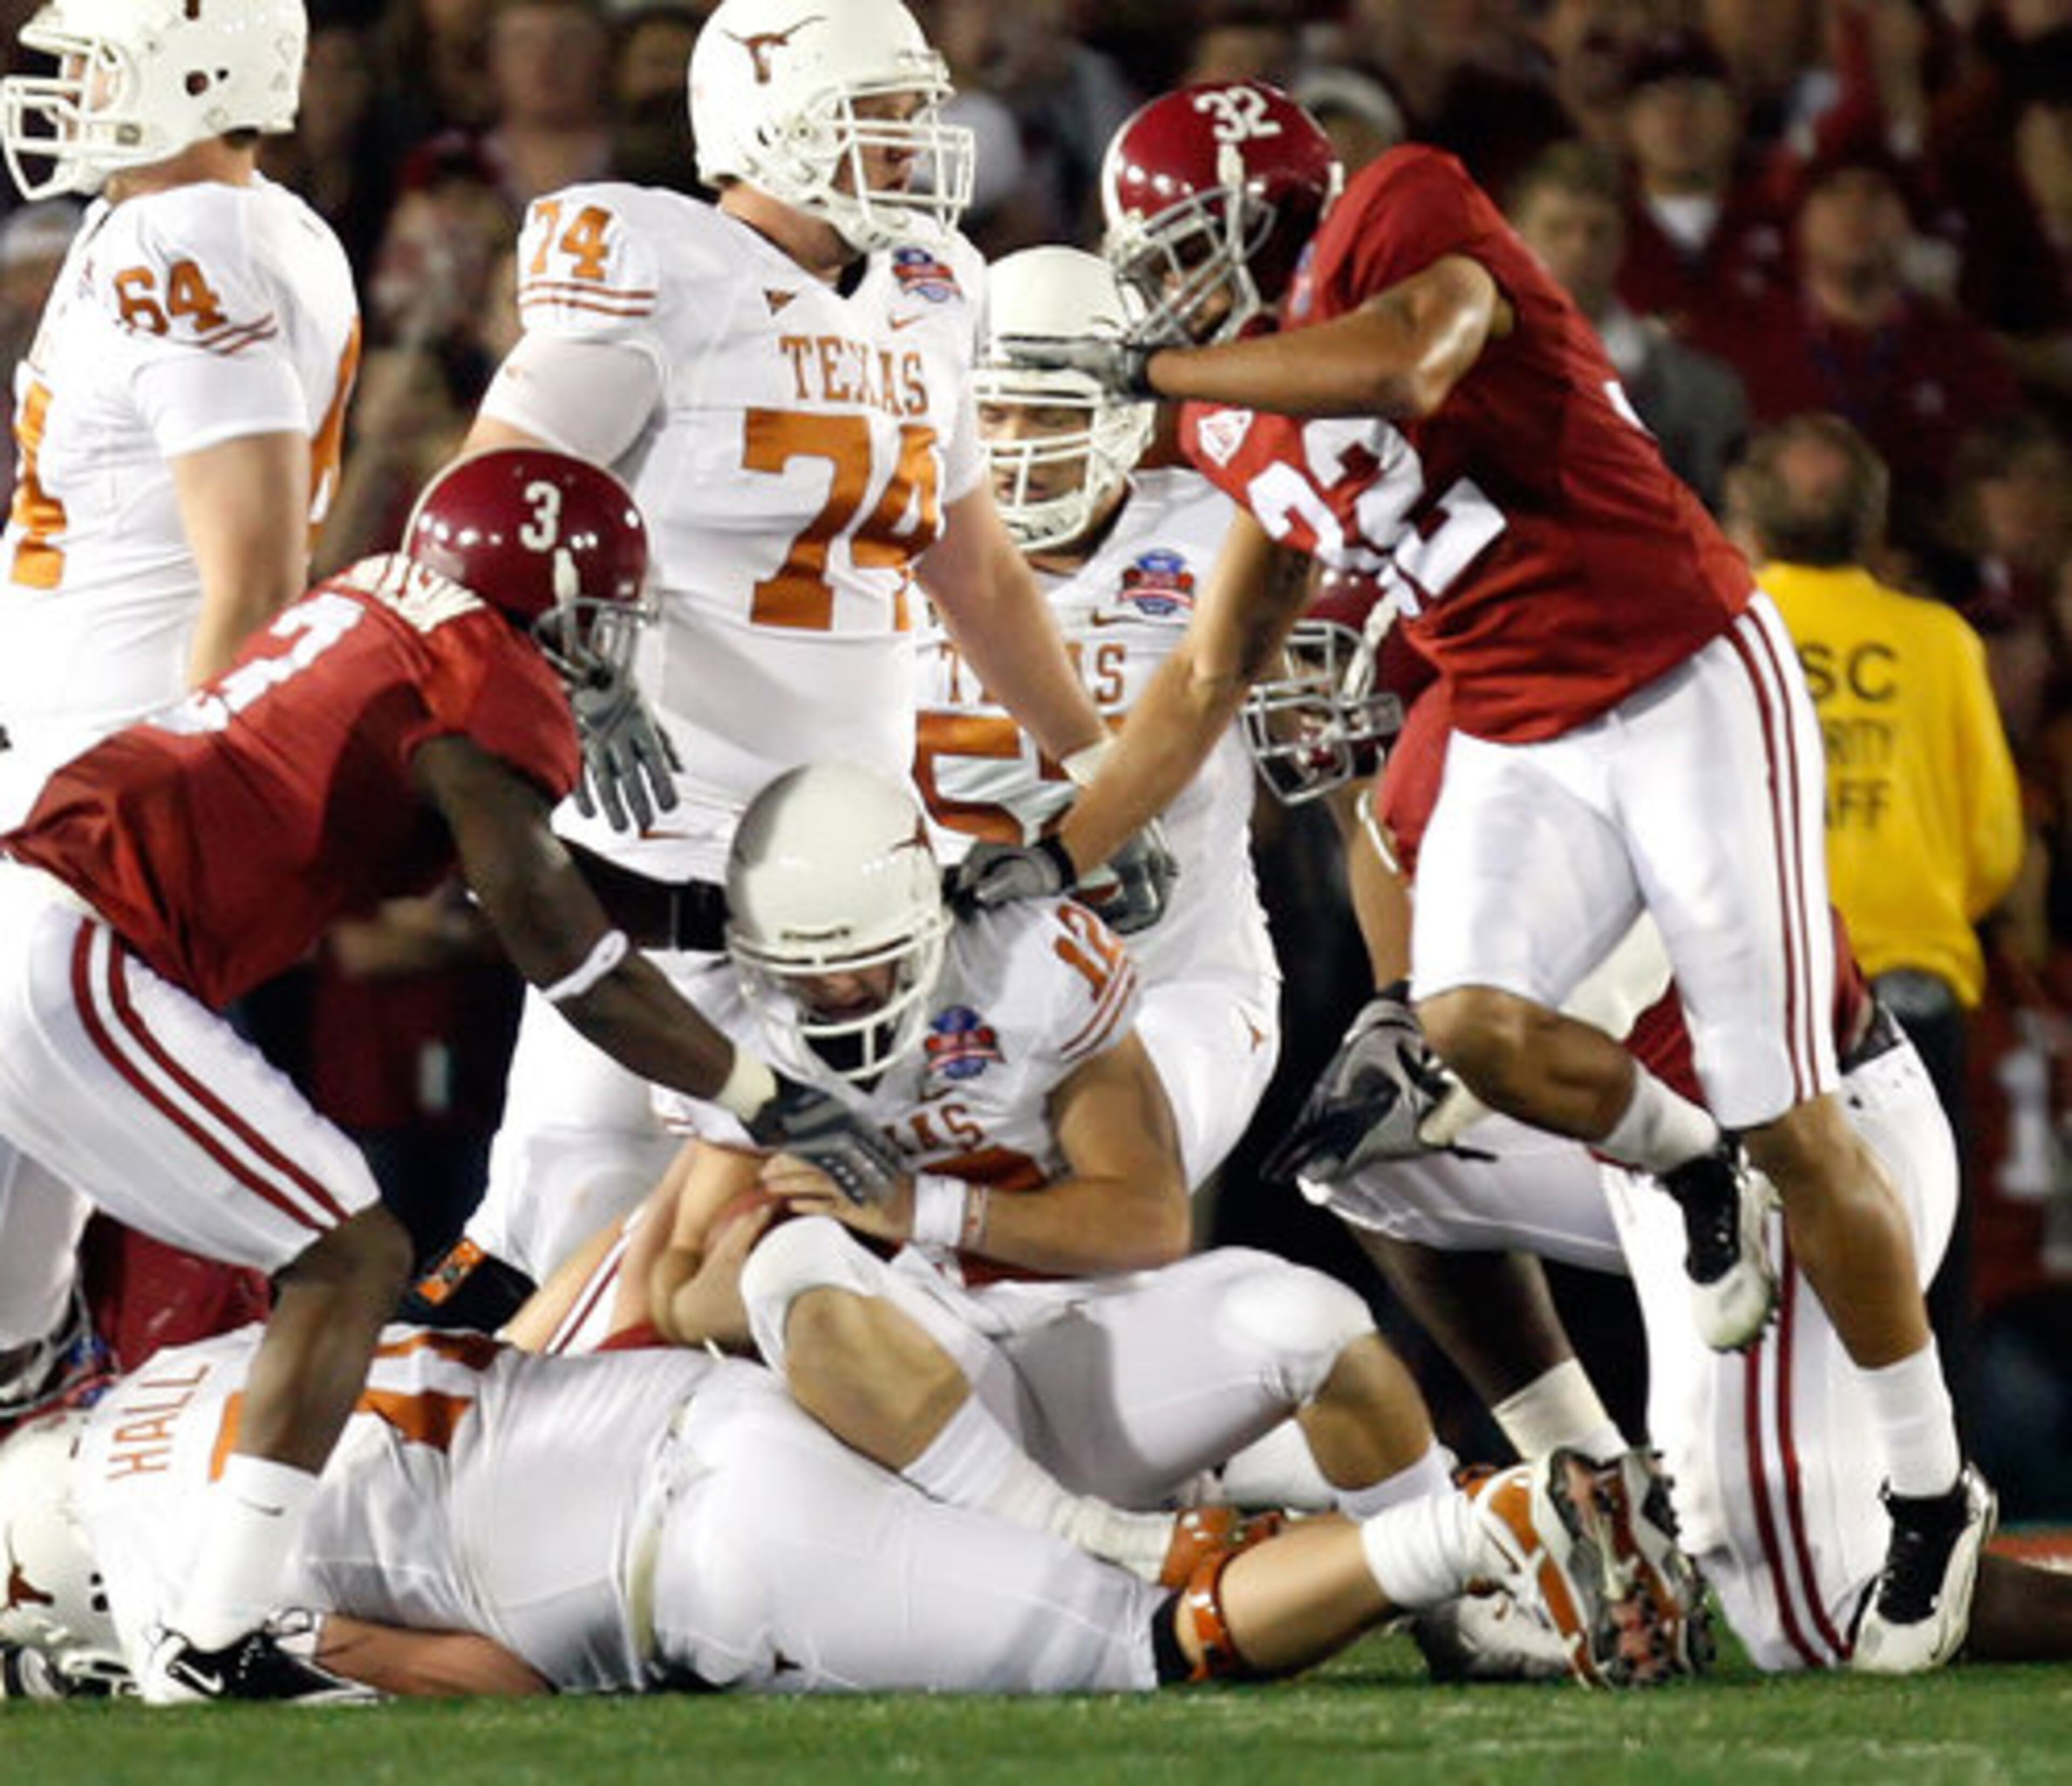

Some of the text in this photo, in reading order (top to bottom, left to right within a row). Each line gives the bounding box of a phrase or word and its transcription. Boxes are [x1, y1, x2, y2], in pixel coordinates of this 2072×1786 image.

[1194, 85, 1282, 142] 32
[530, 199, 613, 283] 74
[114, 259, 229, 337] 64
[779, 335, 929, 415] TEXAS
[520, 480, 562, 551] 3
[741, 407, 938, 631] 74
[1054, 903, 1124, 1003] 12
[106, 1363, 211, 1481] HALL
